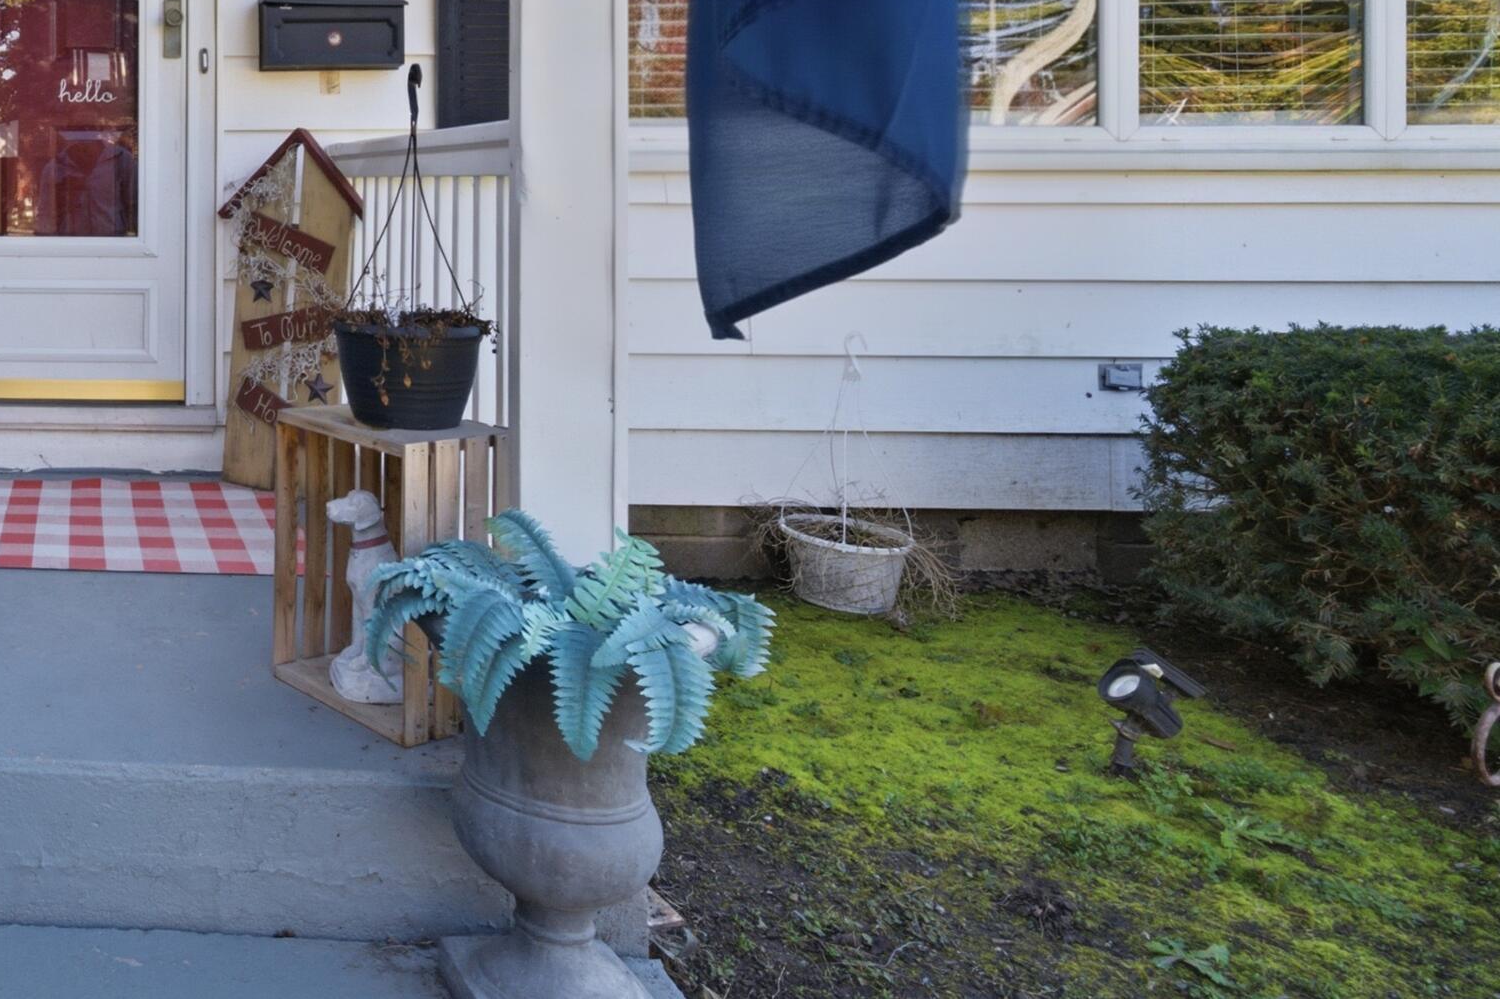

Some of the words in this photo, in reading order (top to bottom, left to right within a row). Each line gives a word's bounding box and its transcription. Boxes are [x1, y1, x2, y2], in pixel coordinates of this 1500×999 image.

[58, 78, 117, 103] hello
[250, 321, 273, 346] To
[281, 314, 318, 342] Our
[253, 393, 276, 423] Ho
